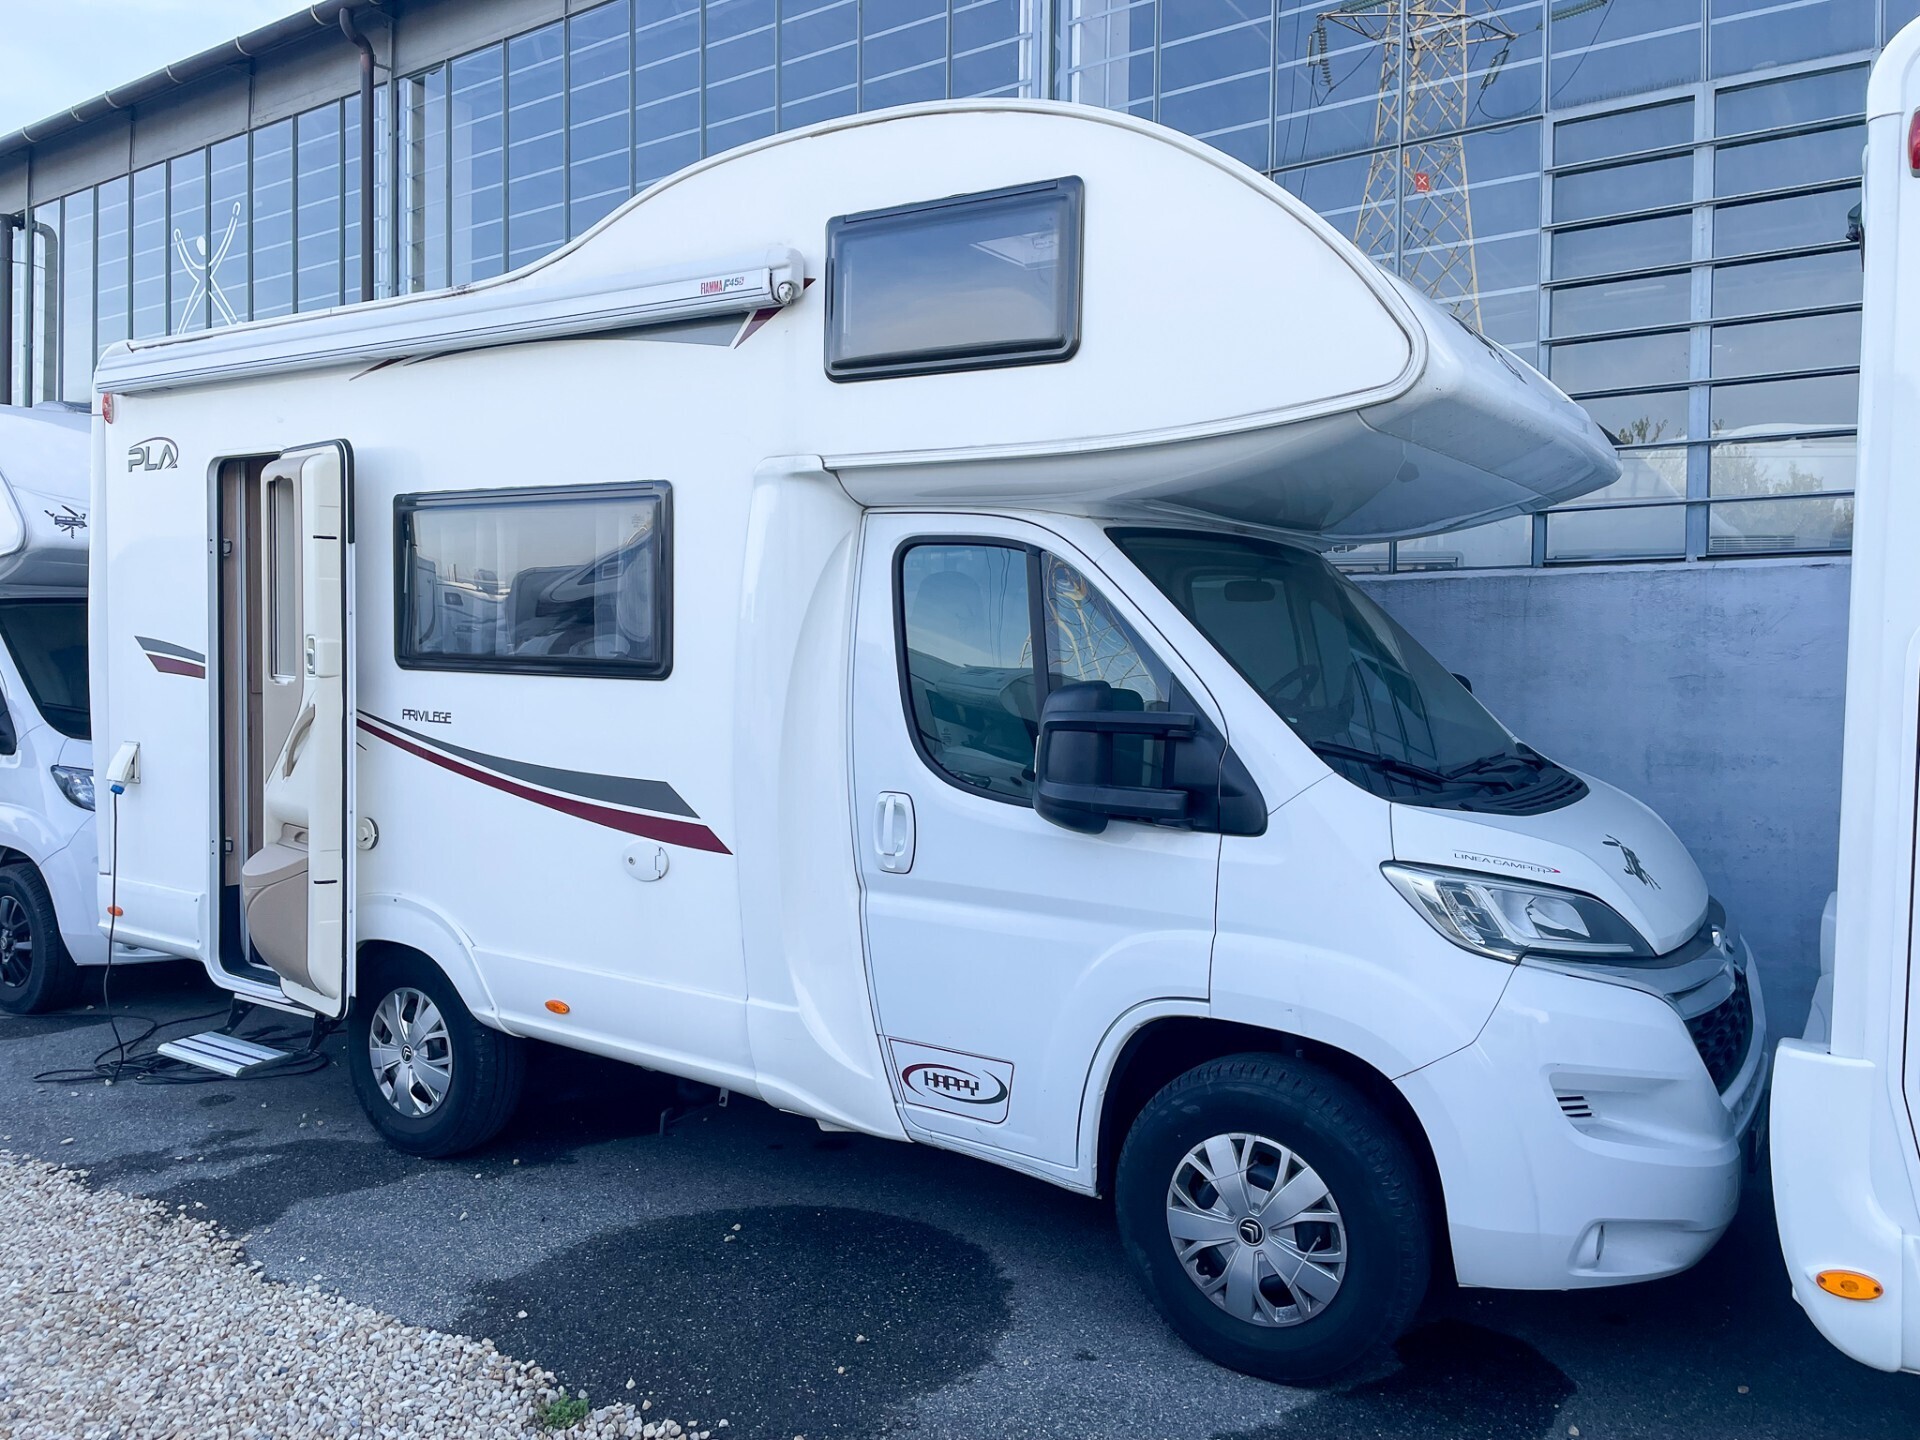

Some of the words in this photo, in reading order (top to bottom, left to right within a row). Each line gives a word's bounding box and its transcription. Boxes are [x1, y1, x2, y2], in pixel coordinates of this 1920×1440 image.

[701, 279, 722, 295] FIAMMA
[128, 443, 177, 472] PLA
[402, 708, 452, 724] PRIVILEGE
[1454, 852, 1491, 863] LINEA
[1493, 859, 1546, 874] CAMPER
[923, 1070, 980, 1096] HAPPY
